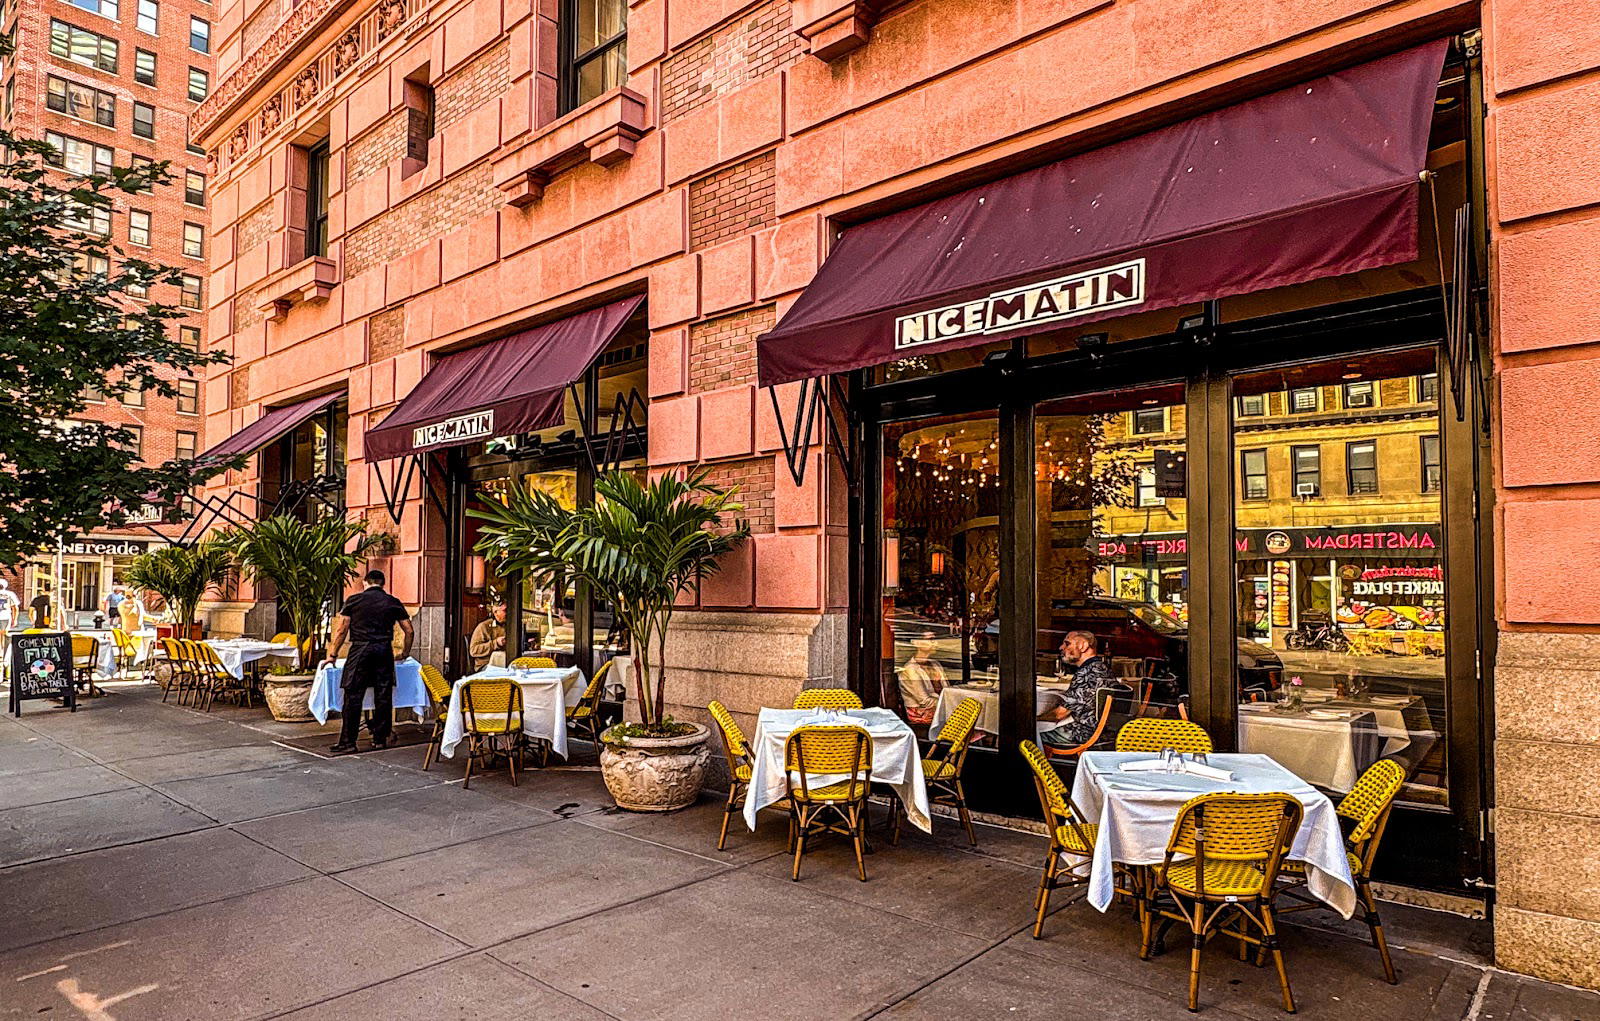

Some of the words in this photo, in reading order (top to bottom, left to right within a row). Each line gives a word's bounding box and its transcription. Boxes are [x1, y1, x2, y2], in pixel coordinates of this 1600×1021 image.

[18, 638, 41, 648] COME
[24, 647, 61, 664] FIFA
[21, 679, 39, 691] BAR
[48, 678, 69, 688] TABLE
